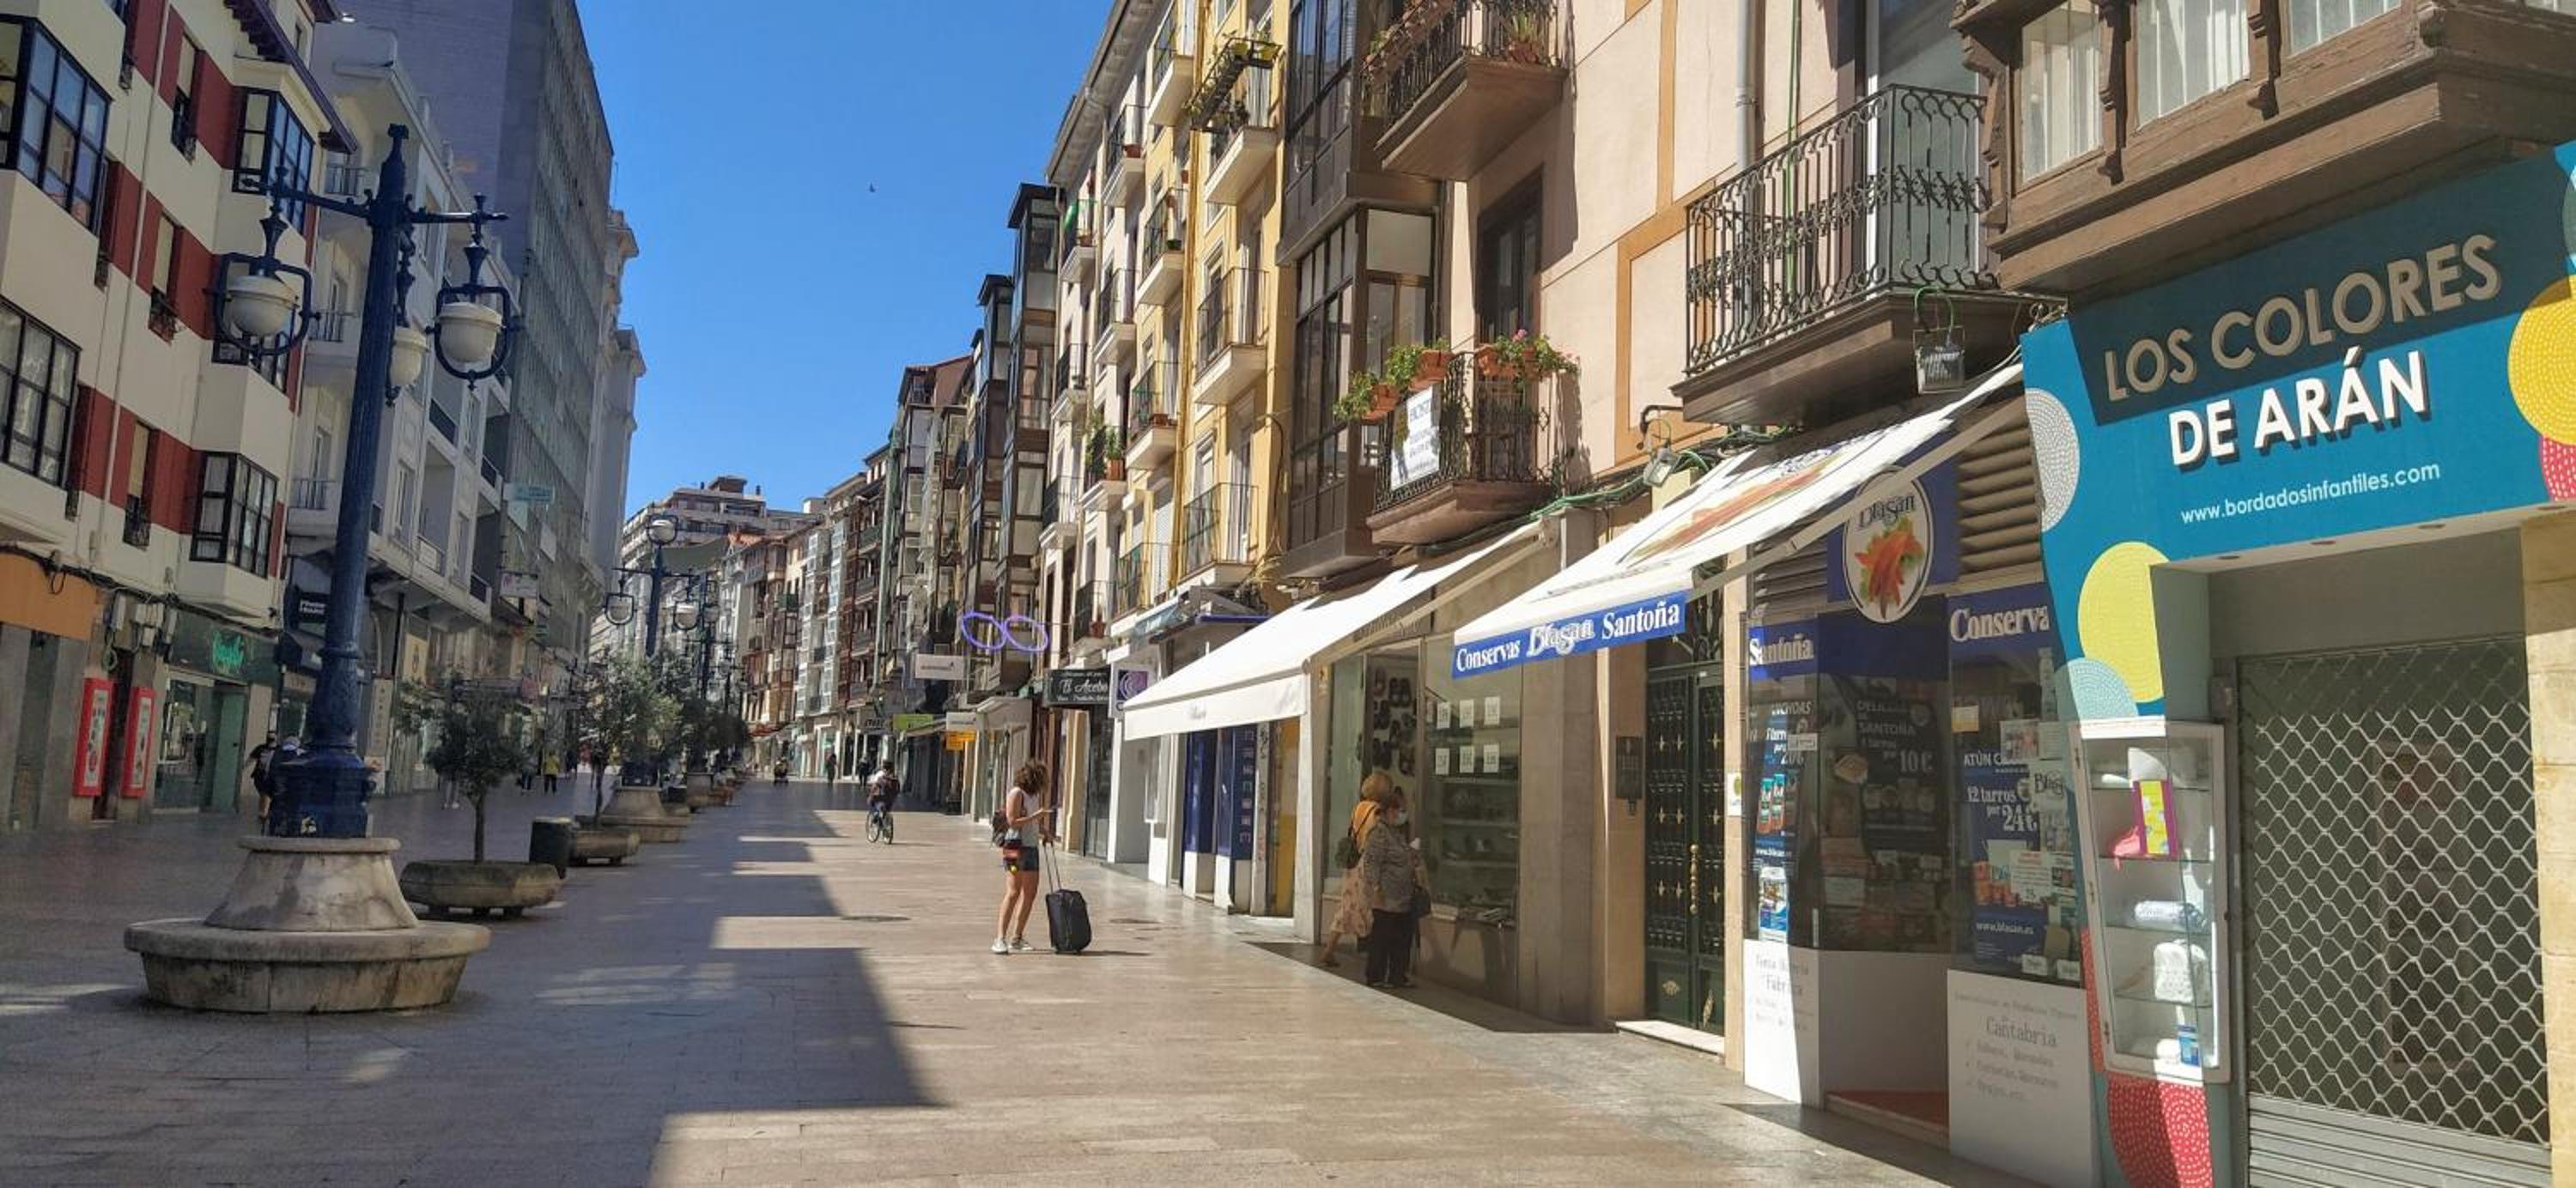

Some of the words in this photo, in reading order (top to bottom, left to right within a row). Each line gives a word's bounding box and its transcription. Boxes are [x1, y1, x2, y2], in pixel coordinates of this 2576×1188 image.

[2105, 328, 2197, 401] LOS
[2210, 233, 2502, 369] COLORES
[2168, 399, 2237, 467] DE
[2253, 346, 2429, 449] ARÁN
[2180, 462, 2441, 524] www.bordadosinfantiles.com
[1455, 640, 1520, 672] Conservas
[1601, 600, 1680, 639] Santoña
[1749, 633, 1814, 666] Santoña
